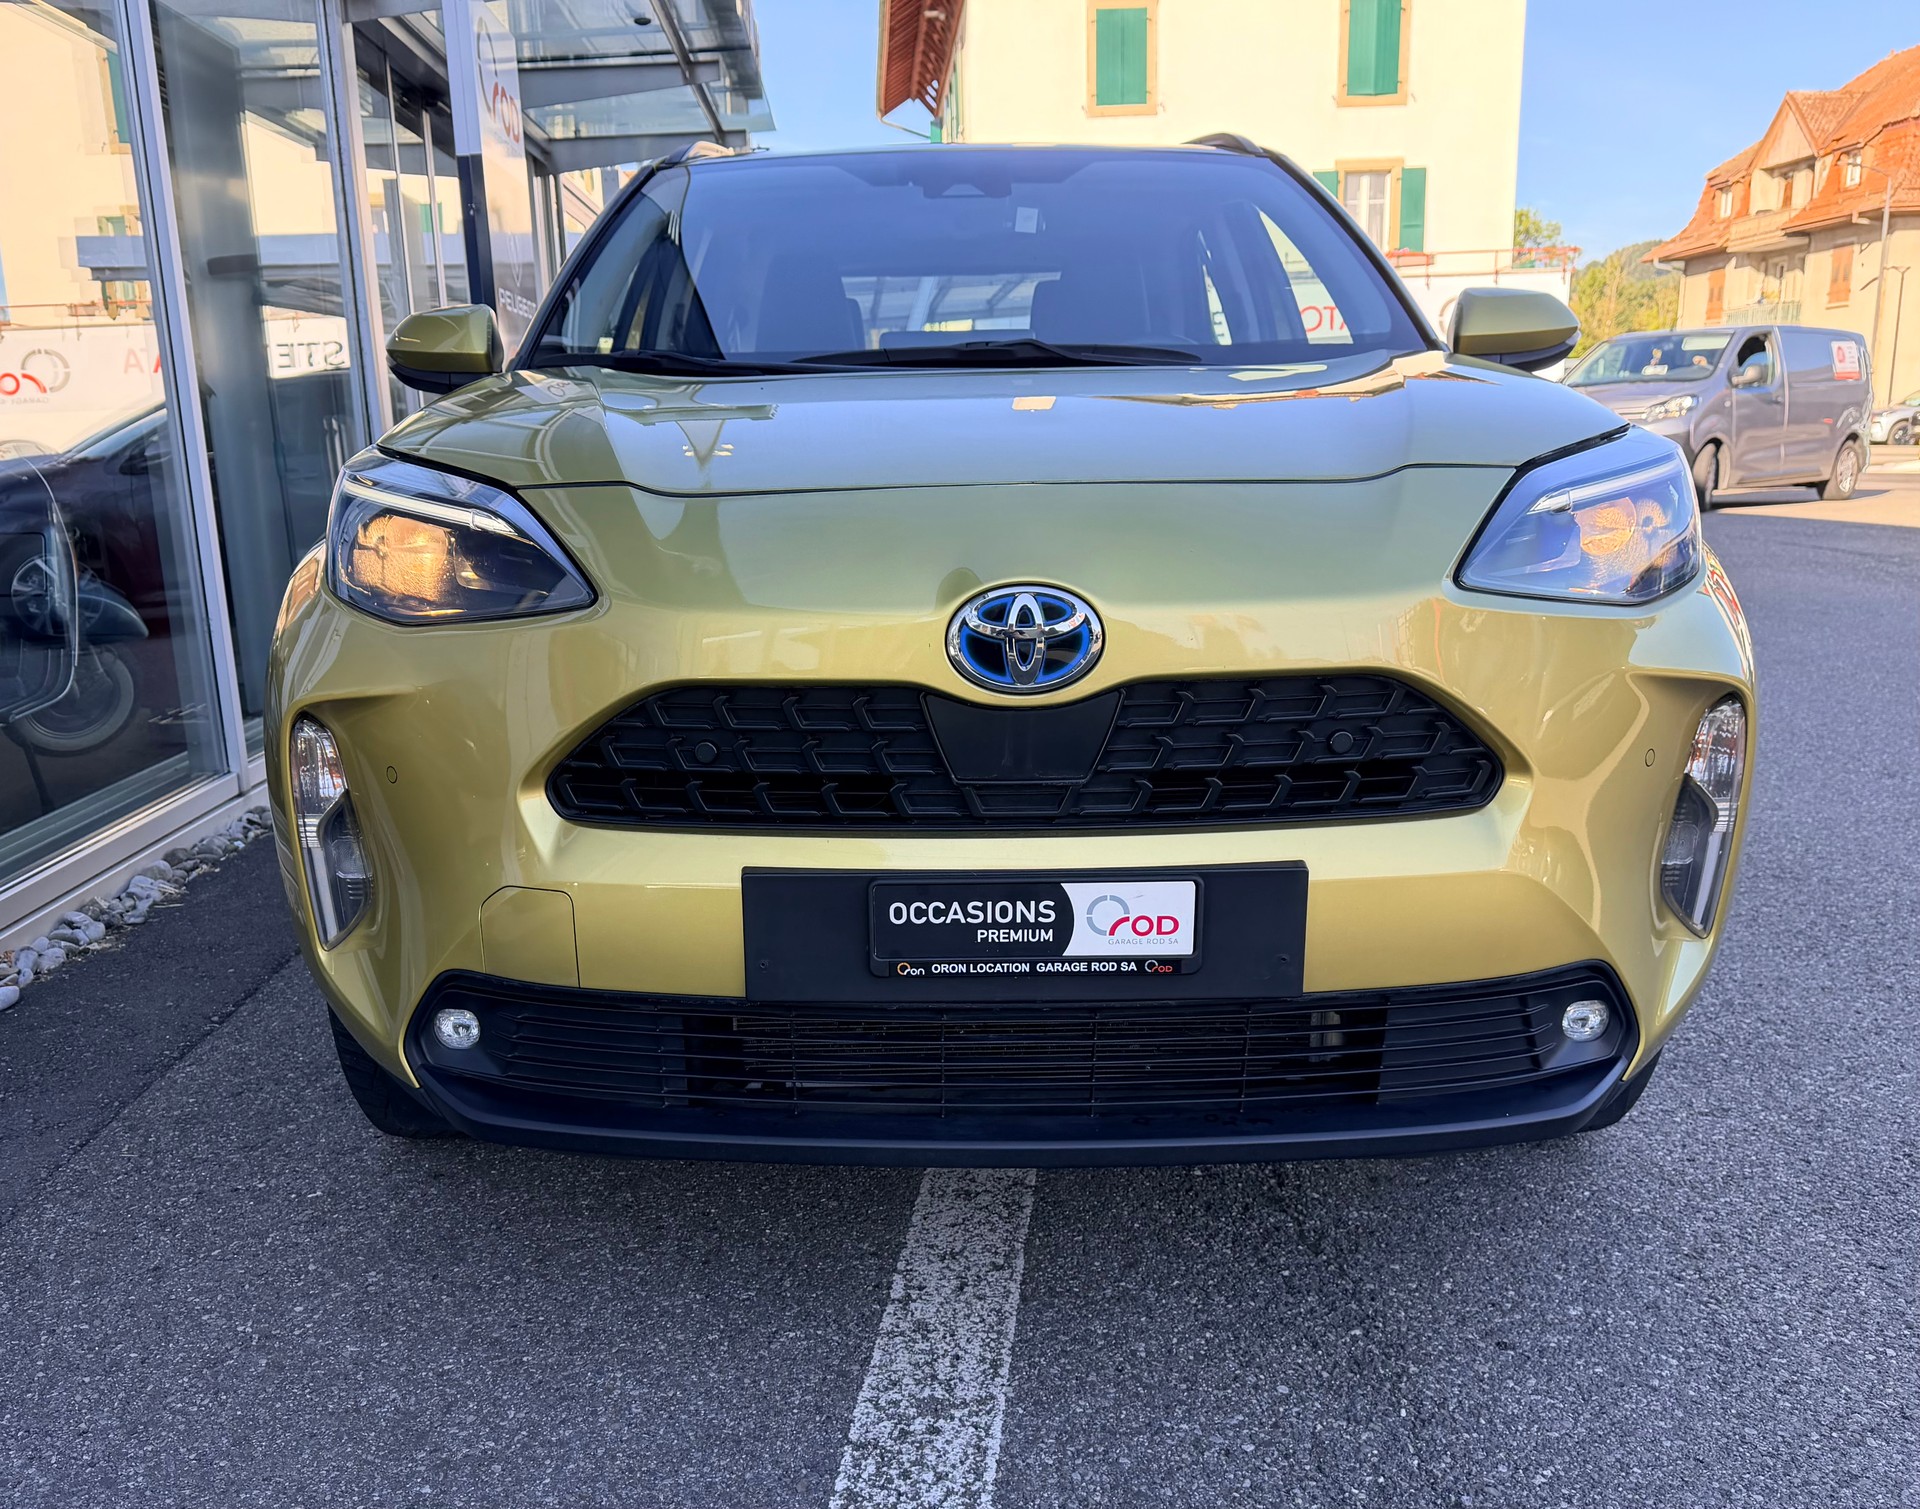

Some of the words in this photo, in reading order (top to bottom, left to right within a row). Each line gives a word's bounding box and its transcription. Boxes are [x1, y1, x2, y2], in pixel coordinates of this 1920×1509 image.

[889, 900, 1056, 925] OCCASIONS
[977, 928, 1054, 943] PREMIUM
[1168, 937, 1179, 945] SA
[931, 963, 967, 973] ORON
[969, 962, 1030, 973] LOCATION
[1036, 962, 1088, 972] GARAGE
[1091, 962, 1118, 972] ROD
[1120, 961, 1138, 972] SA
